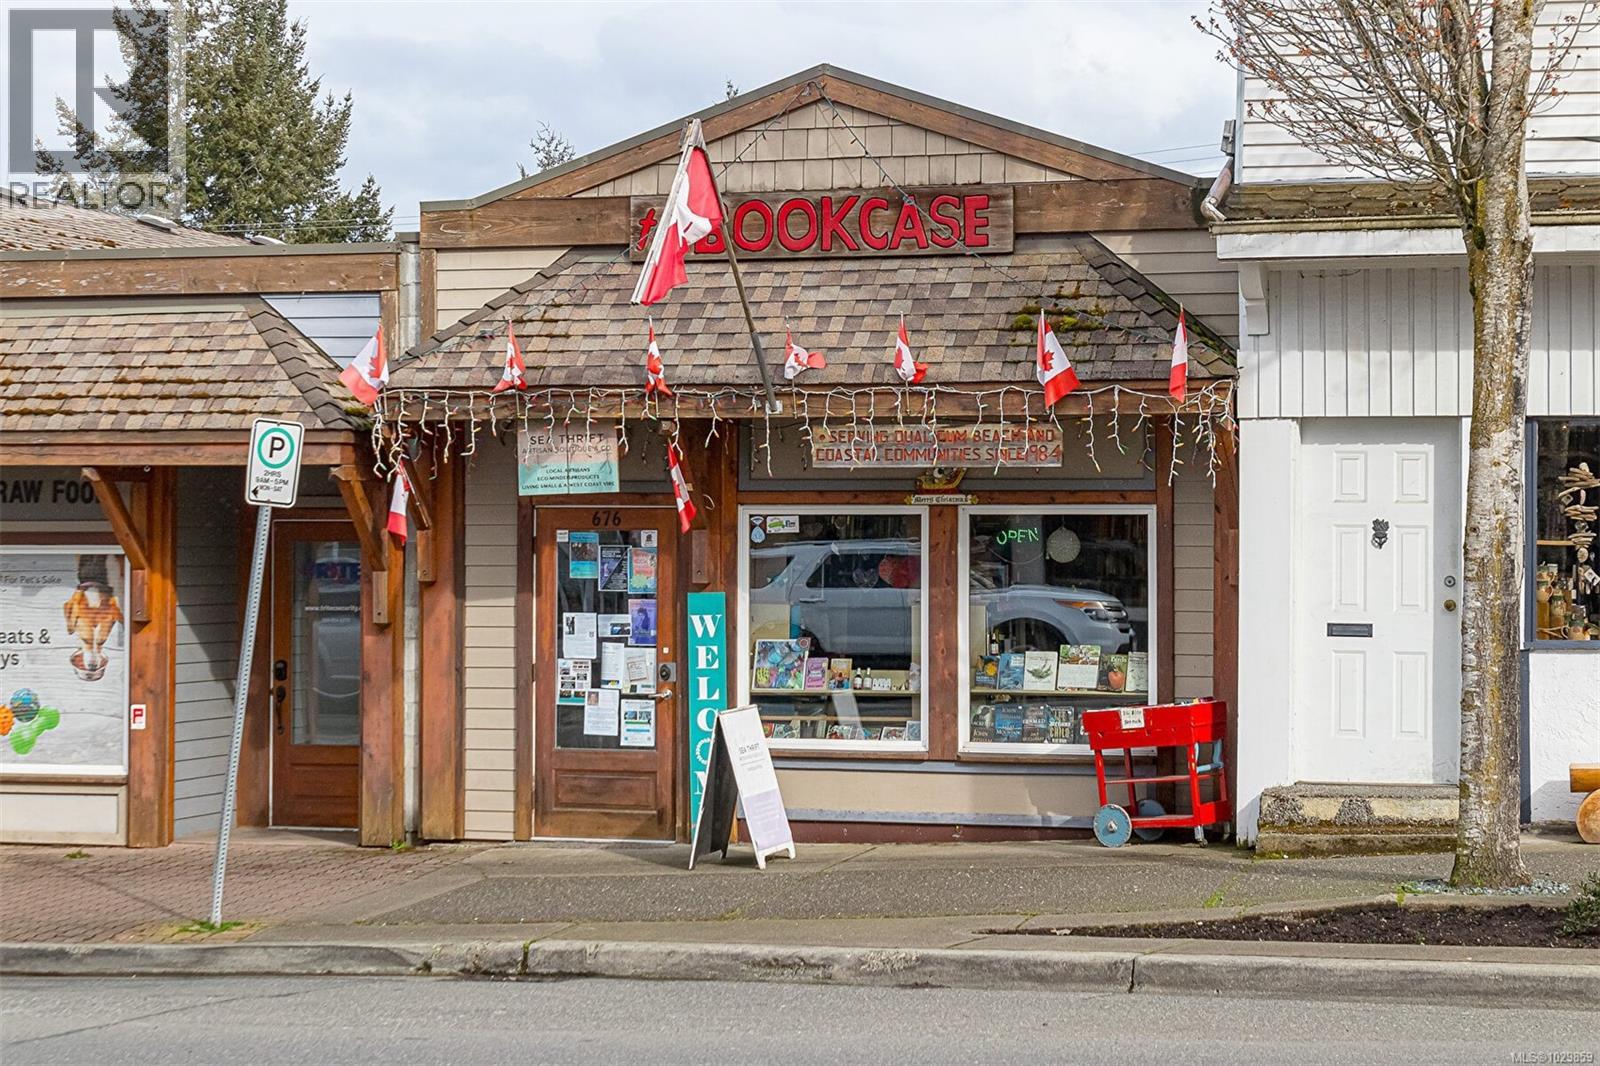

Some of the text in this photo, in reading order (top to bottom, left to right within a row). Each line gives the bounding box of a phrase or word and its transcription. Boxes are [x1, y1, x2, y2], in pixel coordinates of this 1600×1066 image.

[895, 429, 967, 444] QUALCUM
[269, 436, 285, 458] P
[52, 480, 101, 504] FOO
[591, 511, 622, 526] 676
[996, 527, 1039, 545] OPEN
[39, 628, 51, 644] &
